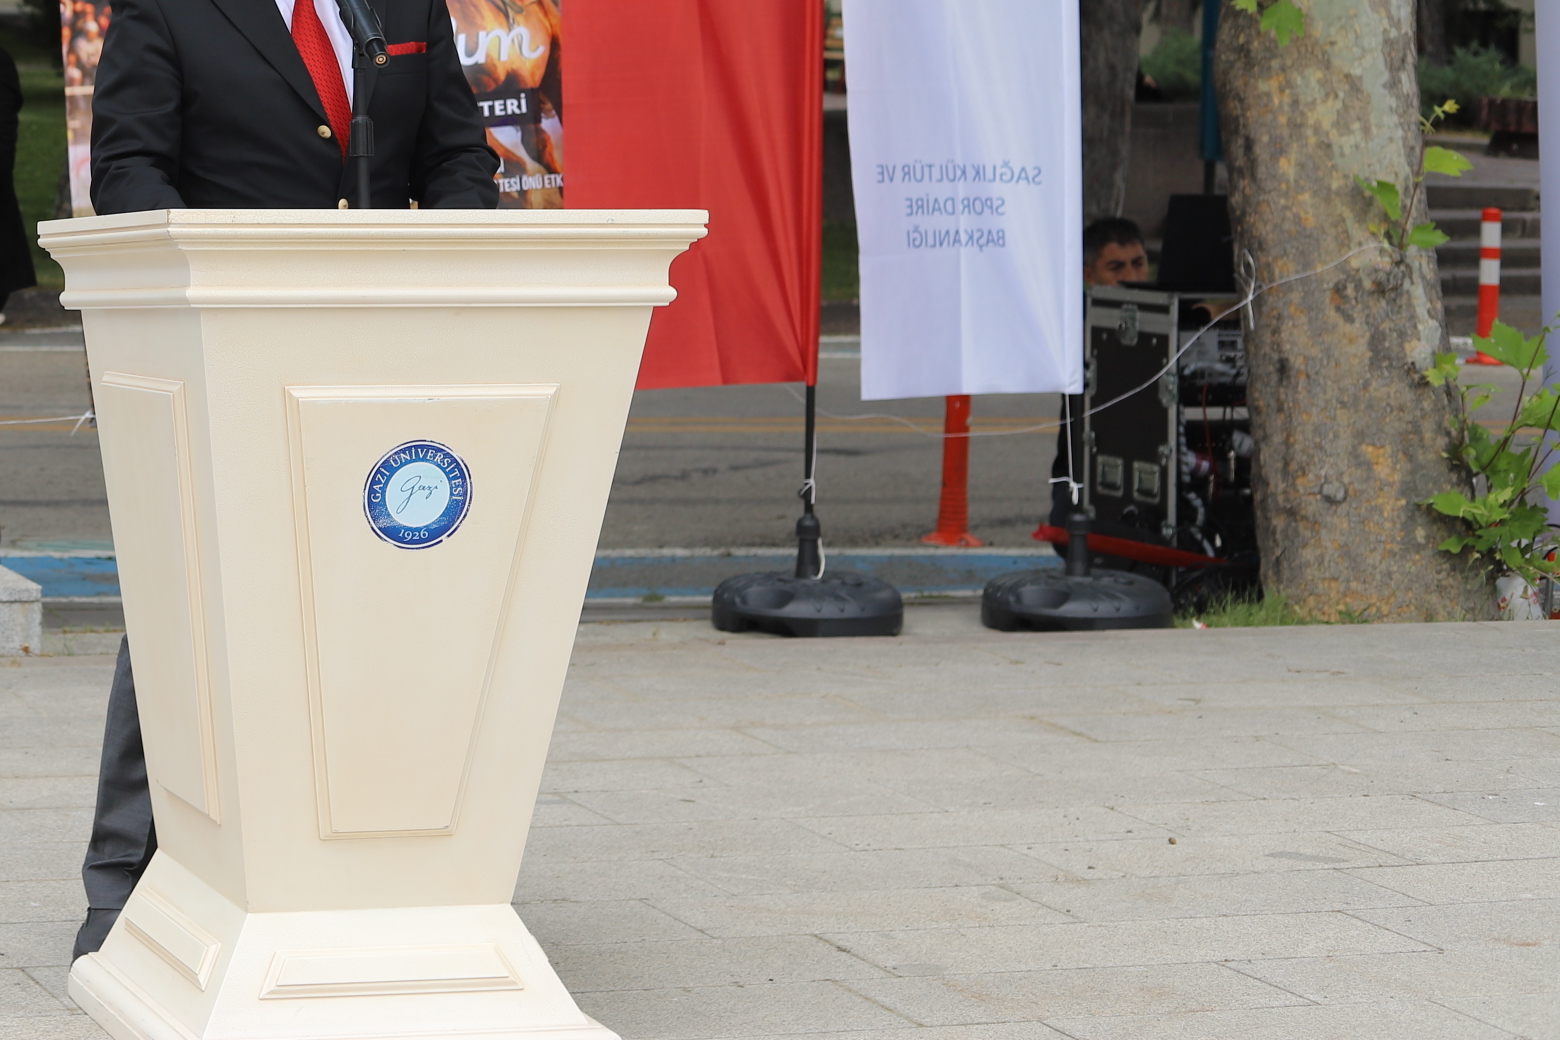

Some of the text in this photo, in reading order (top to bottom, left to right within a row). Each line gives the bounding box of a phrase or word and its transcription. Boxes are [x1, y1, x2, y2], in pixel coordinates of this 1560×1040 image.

[478, 92, 528, 117] TERİ
[522, 173, 543, 189] ÖNÜ
[370, 447, 464, 503] GAZİ ÜNİVERSİTESİ
[395, 475, 443, 514] Gazi
[398, 528, 429, 542] 1926
